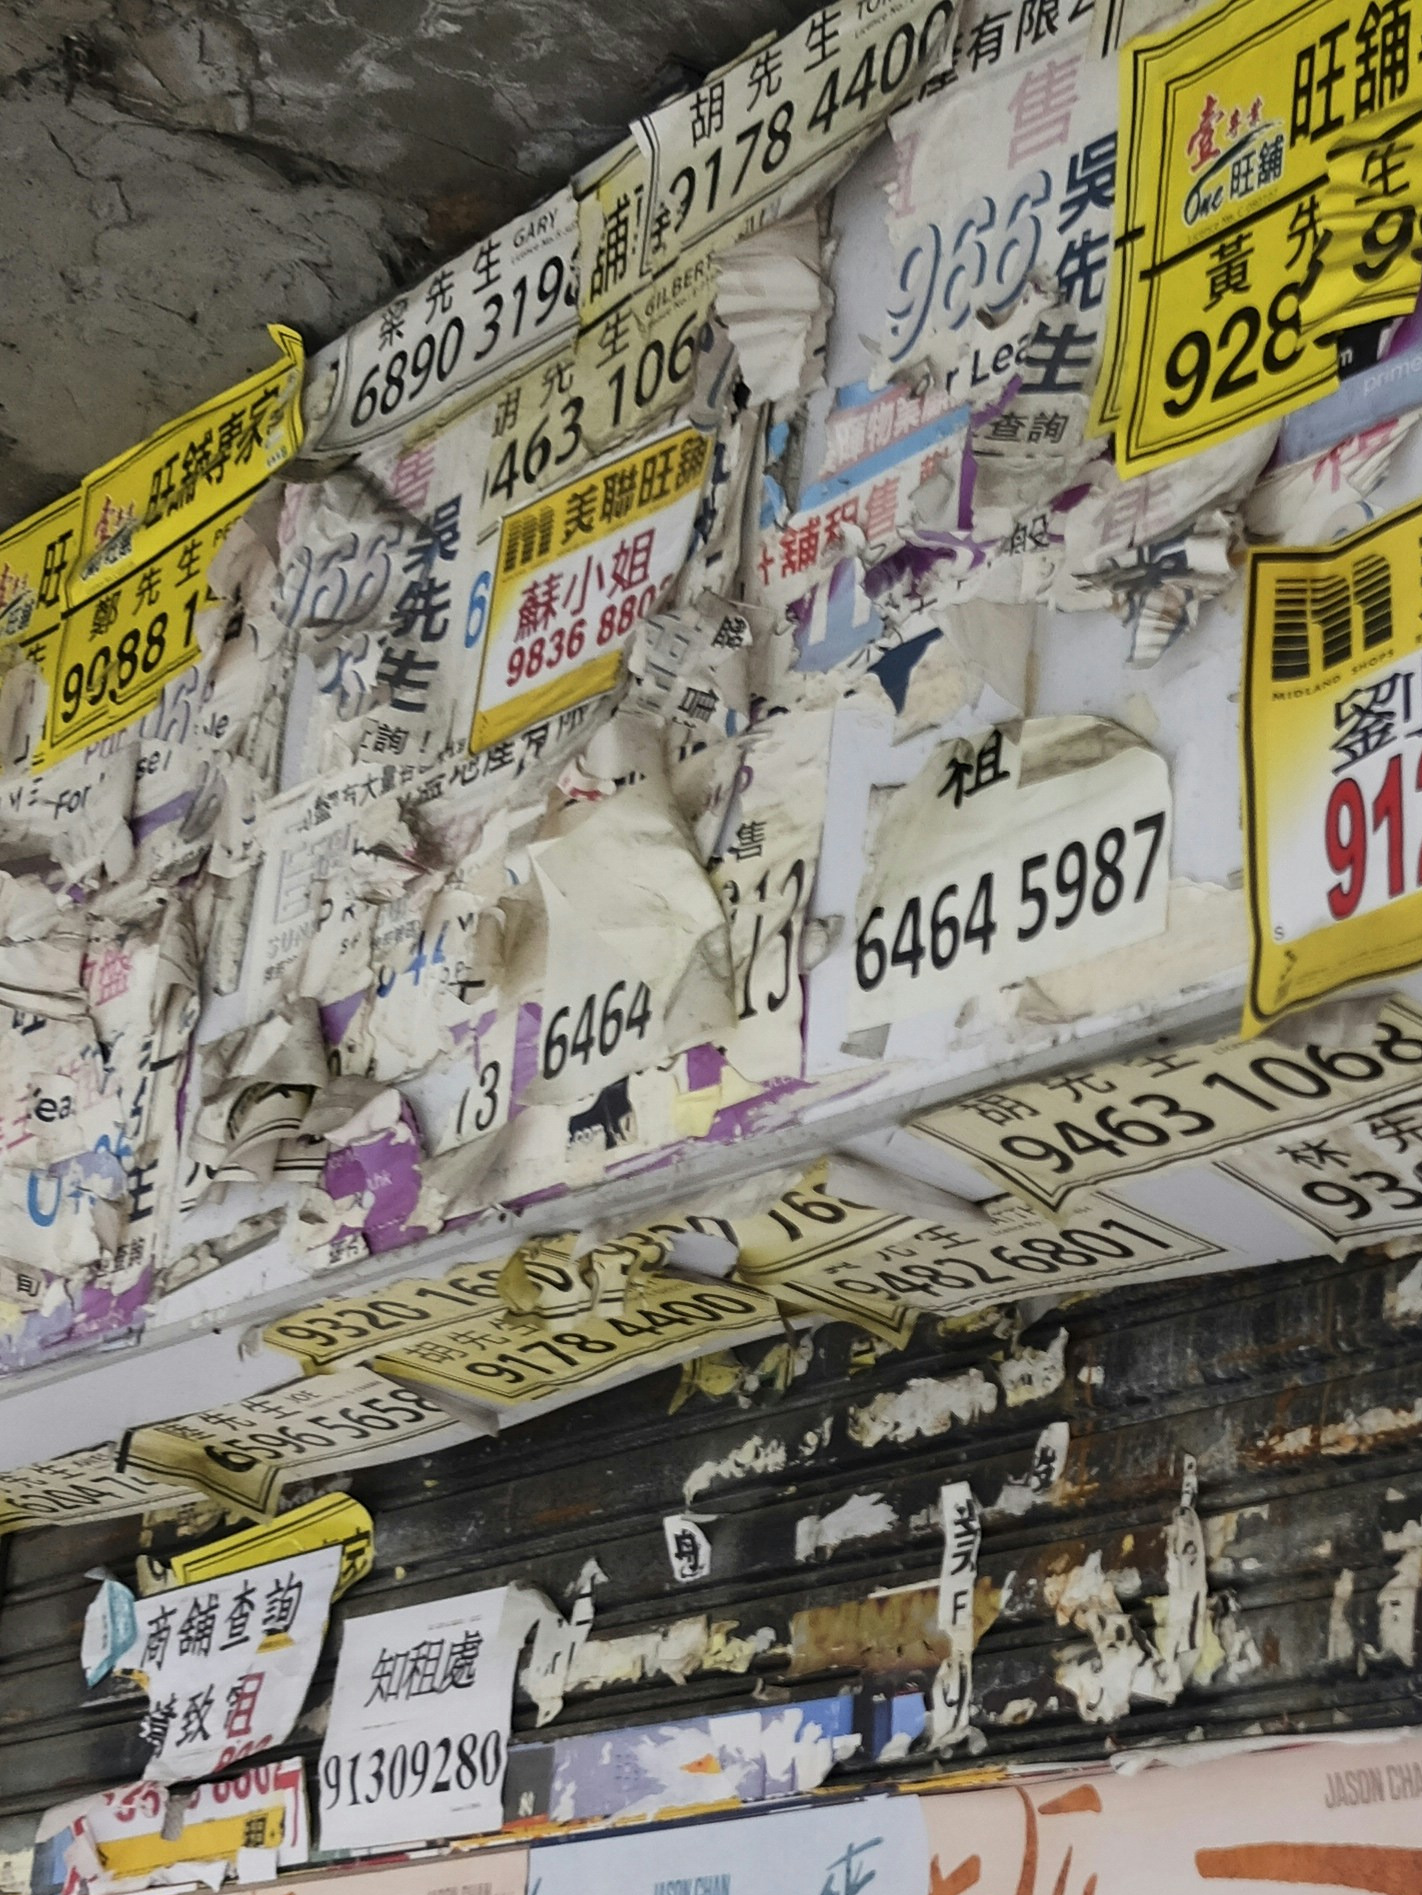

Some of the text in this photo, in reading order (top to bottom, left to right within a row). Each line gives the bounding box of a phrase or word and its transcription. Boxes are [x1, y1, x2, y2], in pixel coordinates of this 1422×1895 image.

[350, 317, 465, 429] 6890
[507, 618, 588, 688] 9836
[938, 729, 1011, 808] 租
[855, 870, 996, 991] 6464
[1017, 810, 1167, 941] 5987
[541, 979, 652, 1080] 6464
[1000, 1093, 1216, 1174] 9463
[990, 1218, 1173, 1274] 6801
[464, 1291, 757, 1386] 9178 4400
[203, 1426, 337, 1473] 6596
[323, 1728, 501, 1811] 91309280
[1325, 1767, 1386, 1809] JASON
